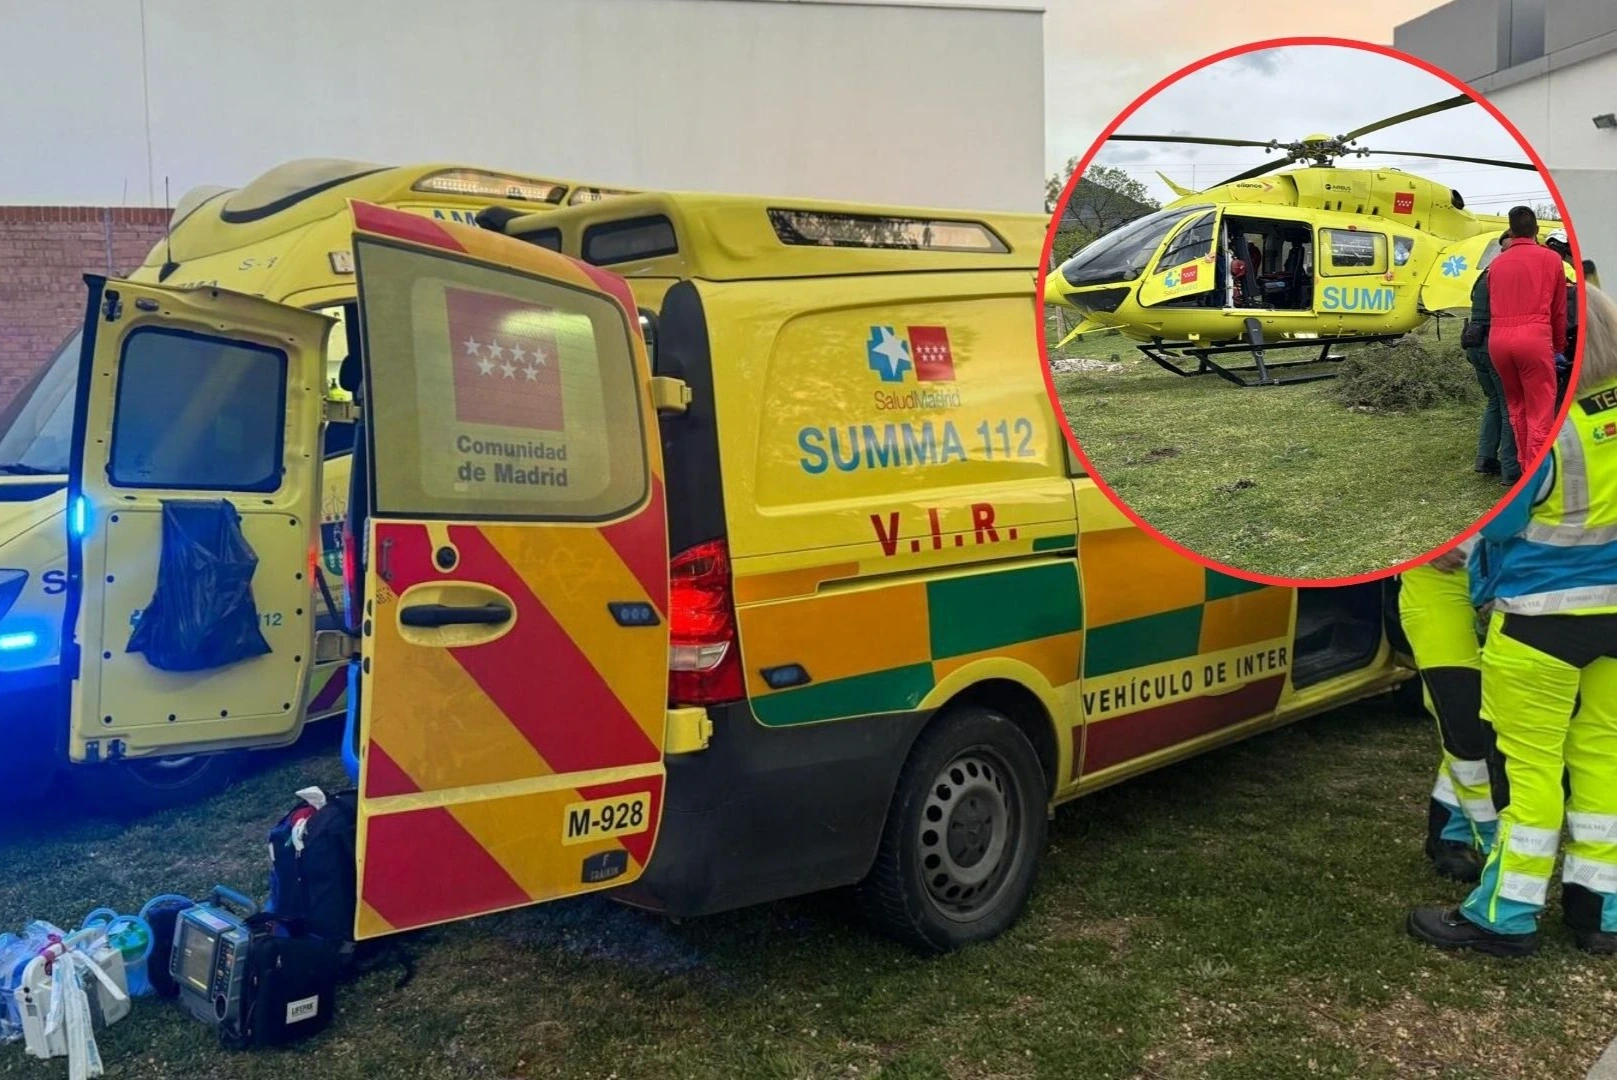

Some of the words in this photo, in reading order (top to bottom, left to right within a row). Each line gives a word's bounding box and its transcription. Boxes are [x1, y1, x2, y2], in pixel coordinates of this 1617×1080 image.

[873, 389, 963, 411] SaludMadrid
[456, 434, 568, 461] Comunidad
[797, 420, 968, 475] SUMMA
[976, 417, 1036, 459] 112
[457, 460, 487, 482] de
[494, 462, 569, 487] Madrid
[869, 501, 1019, 557] V.I.R.
[1083, 670, 1193, 716] VEHÍCULO
[1204, 662, 1227, 688] DE
[1236, 647, 1288, 679] INTER
[568, 800, 644, 838] M-928
